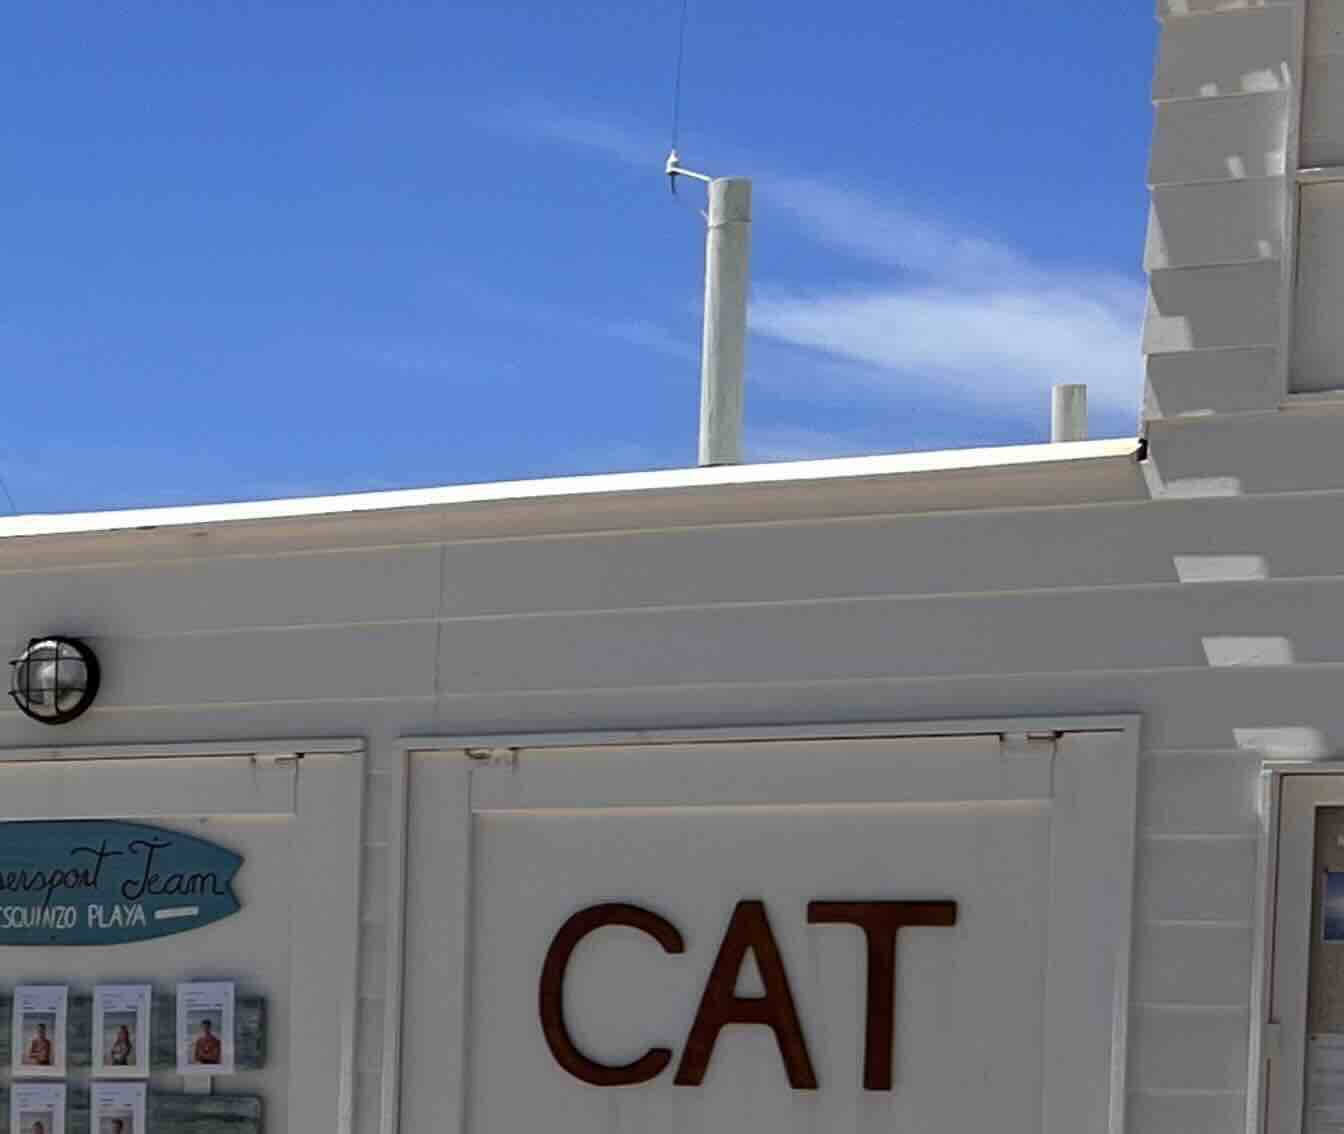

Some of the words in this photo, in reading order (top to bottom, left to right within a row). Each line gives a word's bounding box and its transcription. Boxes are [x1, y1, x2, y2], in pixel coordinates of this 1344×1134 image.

[121, 838, 225, 900] Team
[87, 903, 147, 928] PLAYA
[539, 900, 957, 1090] CAT
